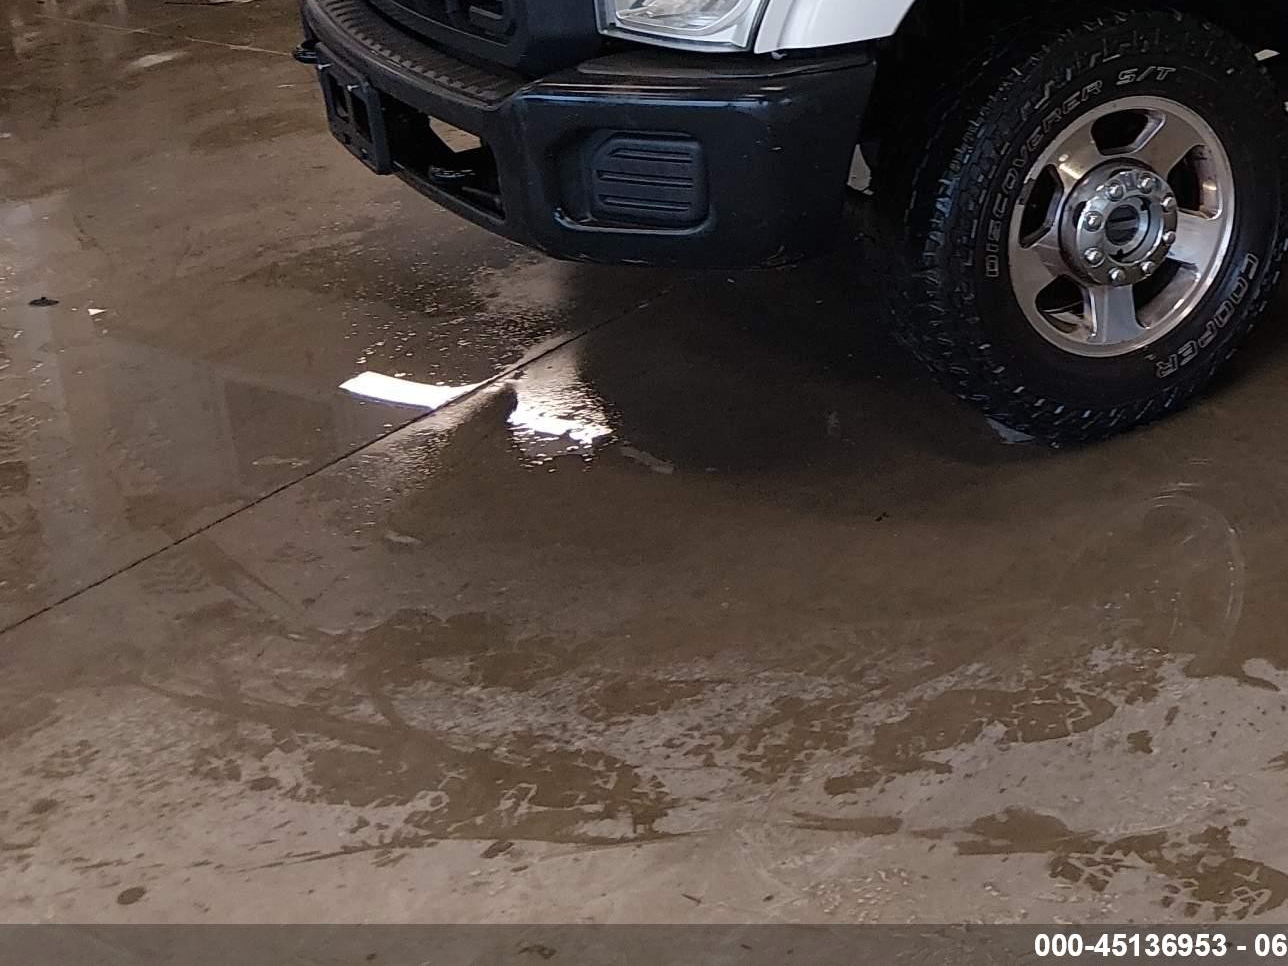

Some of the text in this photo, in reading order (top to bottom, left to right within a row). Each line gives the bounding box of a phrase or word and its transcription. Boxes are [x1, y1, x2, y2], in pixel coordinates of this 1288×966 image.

[986, 66, 1176, 277] DISCOVERER S/T
[1156, 253, 1259, 378] COOPER
